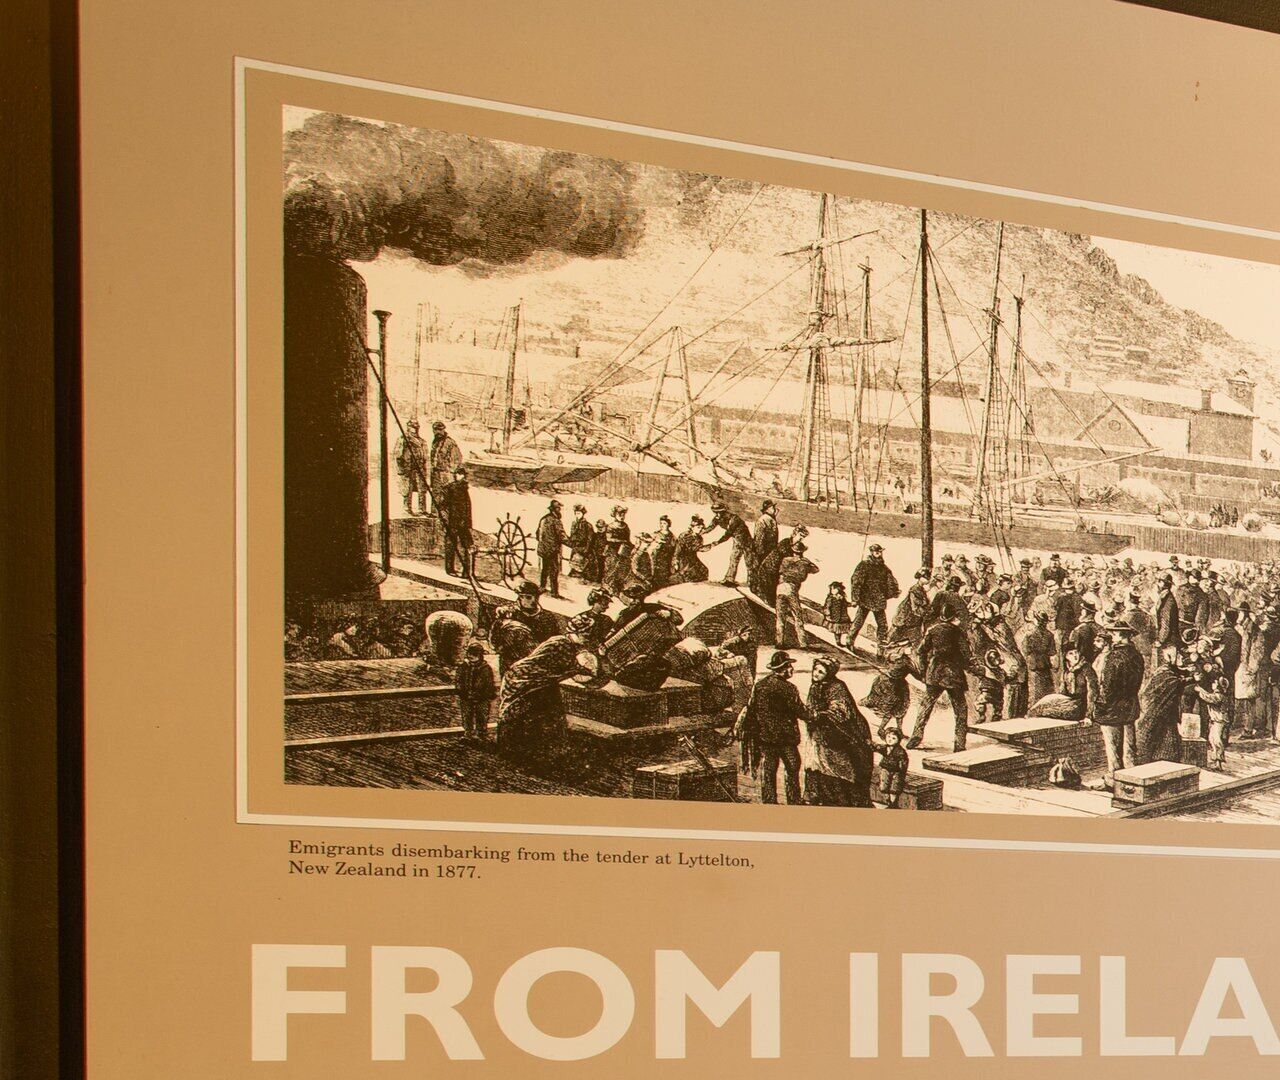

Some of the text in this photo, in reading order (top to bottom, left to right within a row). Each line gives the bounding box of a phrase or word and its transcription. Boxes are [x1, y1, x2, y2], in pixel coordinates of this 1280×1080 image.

[288, 840, 754, 869] Emigrants disembarking from the tender at Lyttelton,
[288, 860, 481, 879] New Zealand in 1877.
[252, 944, 780, 1061] FROM
